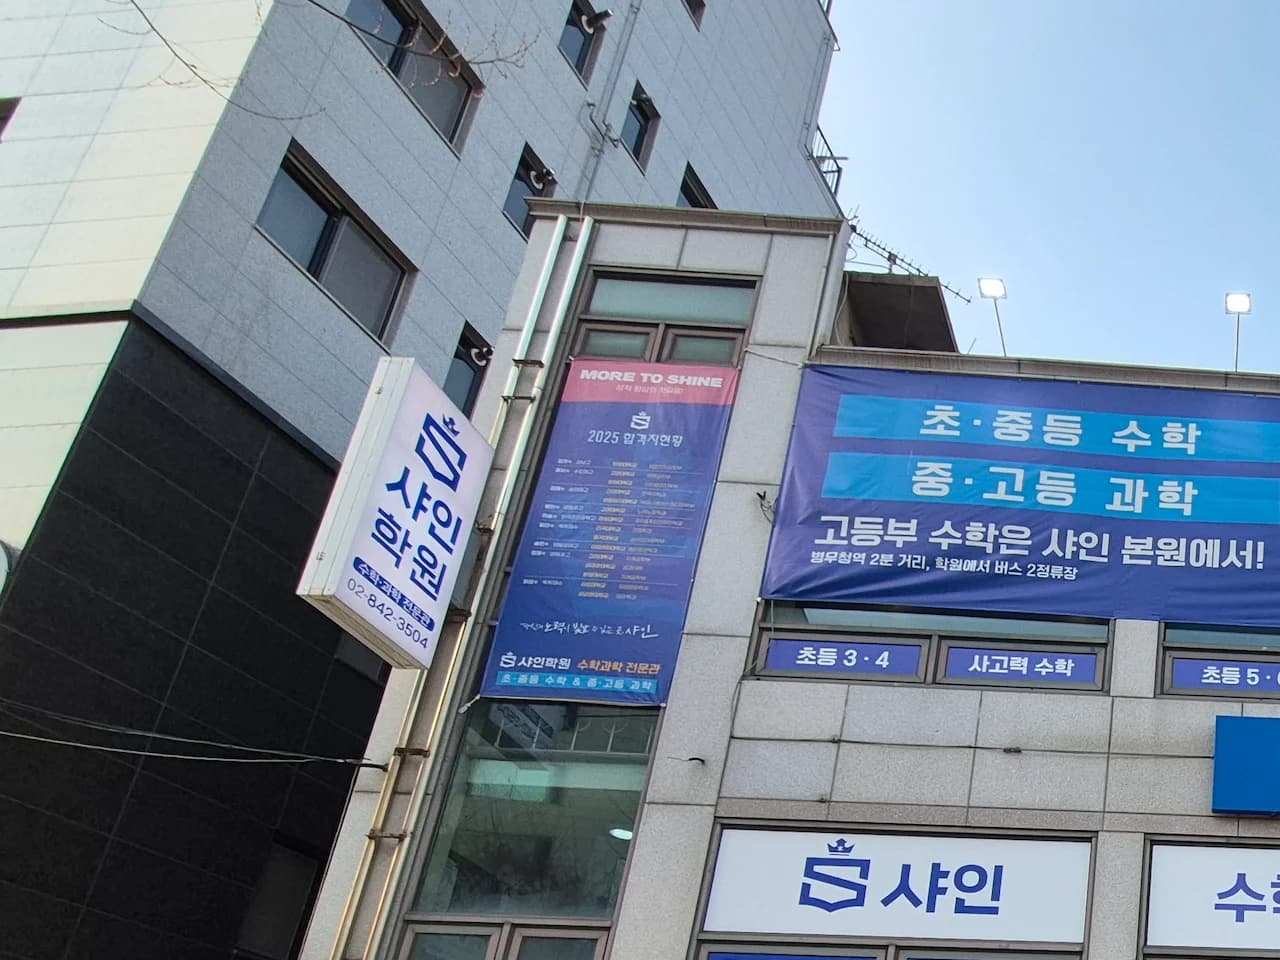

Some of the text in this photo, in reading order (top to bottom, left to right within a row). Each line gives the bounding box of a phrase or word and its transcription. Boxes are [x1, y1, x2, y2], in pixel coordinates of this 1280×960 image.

[580, 369, 723, 388] MORE TO SHINE
[587, 430, 620, 445] 2025
[1112, 420, 1201, 455] 수학
[386, 466, 463, 555] 샤인
[1105, 477, 1198, 516] 과학
[371, 507, 447, 601] 학원
[814, 515, 1266, 570] 고등부 수학은 샤인 본원에서!
[810, 549, 1078, 581] 병무청역 2분 거리, 학원에서 버스 2정류장
[346, 577, 429, 649] 02-842-3504
[518, 656, 572, 670] 샤인학원
[576, 658, 624, 673] 수학과학
[626, 661, 662, 675] 전문관
[795, 646, 838, 667] 초등
[968, 654, 1075, 678] 사고력 수학
[545, 674, 567, 686] 수학
[572, 676, 581, 687] &
[630, 679, 653, 690] 과학
[1201, 665, 1241, 686] 초등
[880, 862, 1004, 915] 샤인
